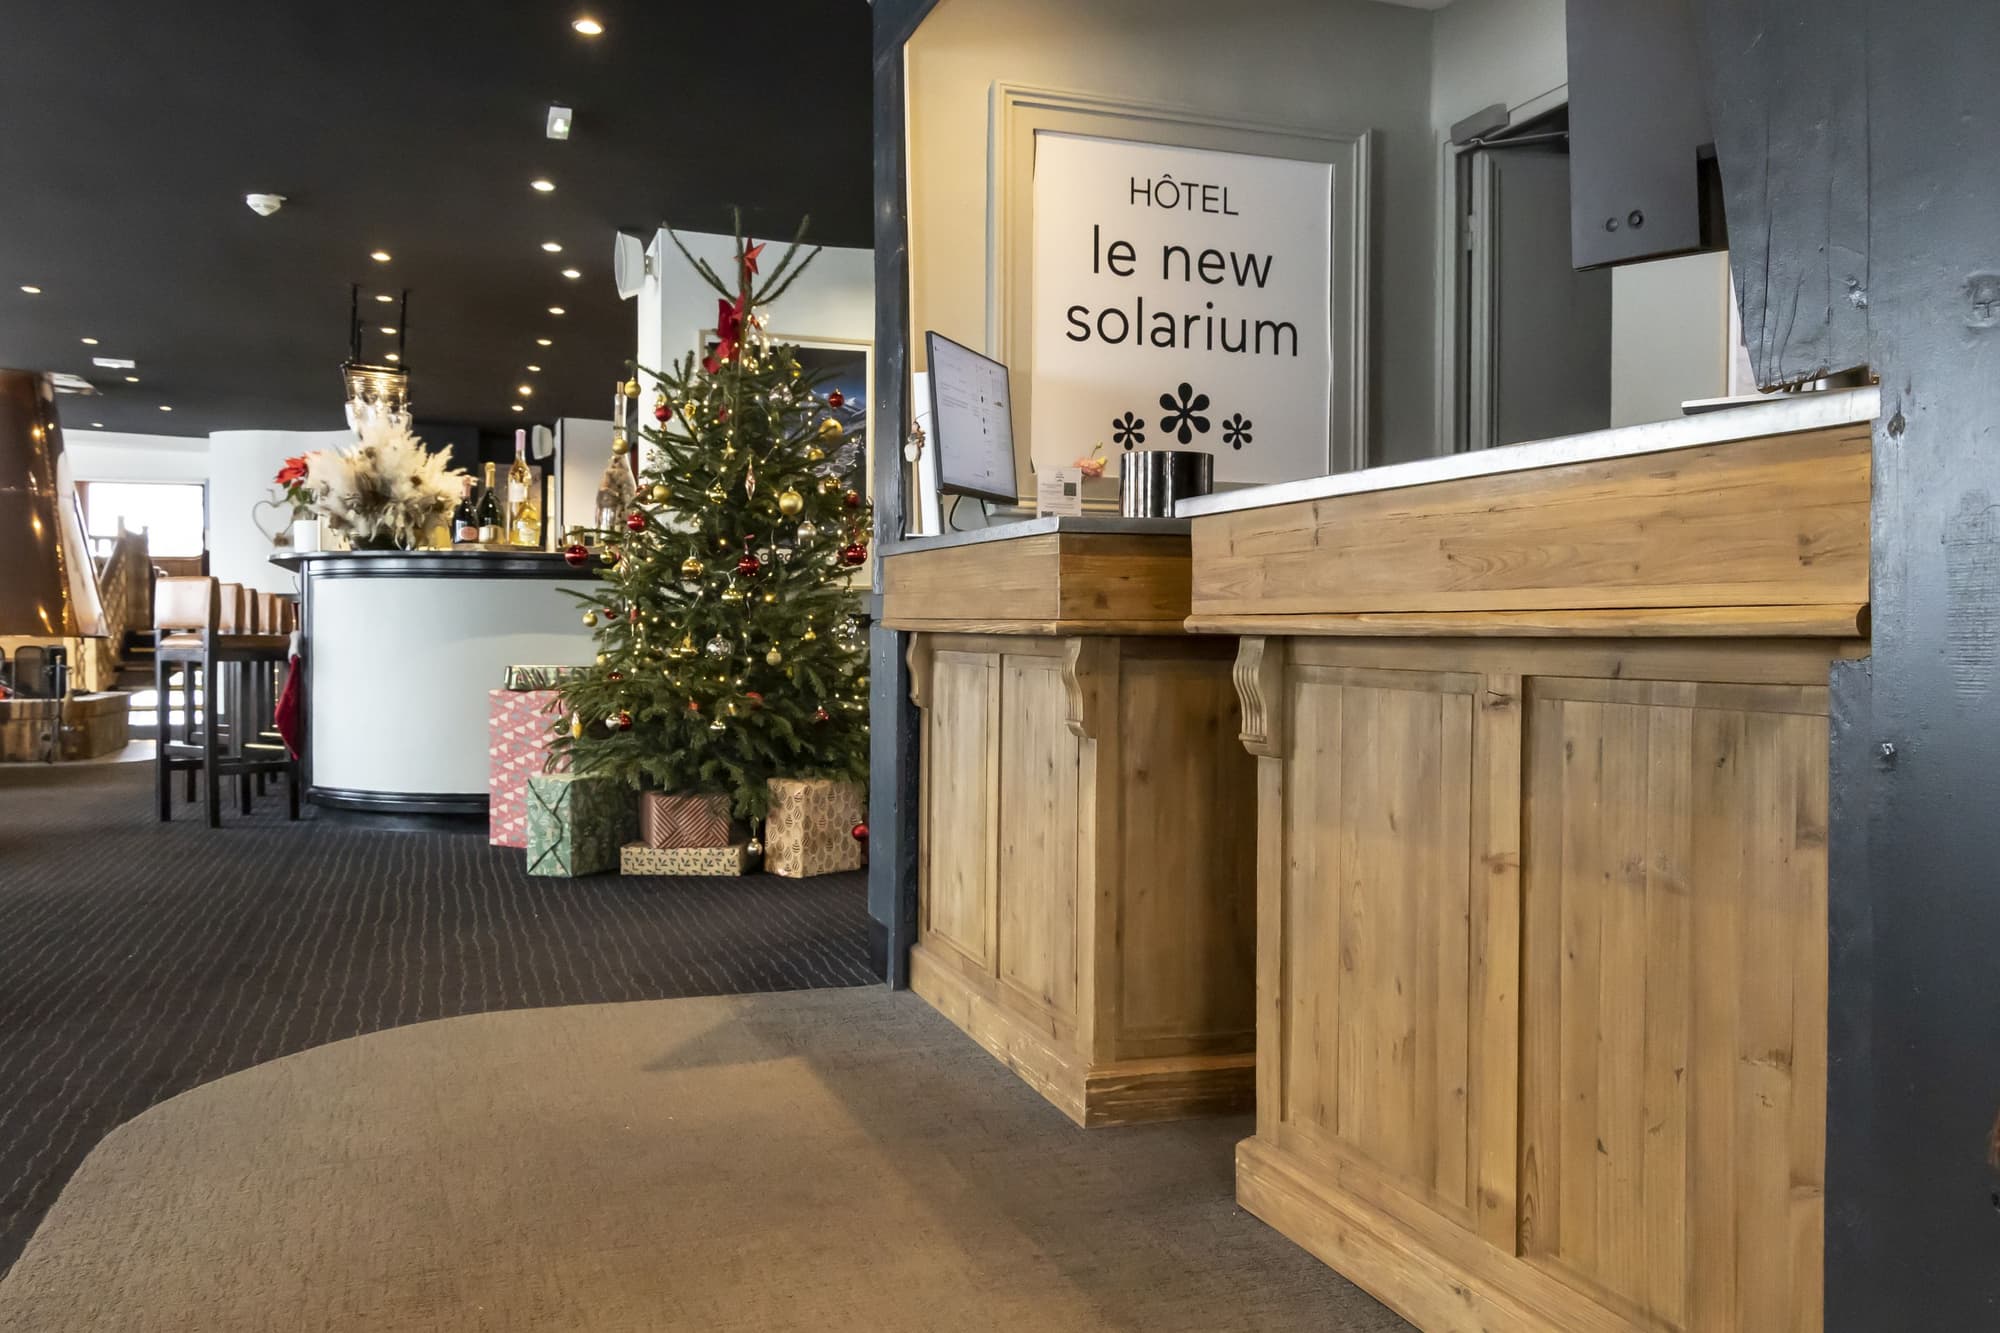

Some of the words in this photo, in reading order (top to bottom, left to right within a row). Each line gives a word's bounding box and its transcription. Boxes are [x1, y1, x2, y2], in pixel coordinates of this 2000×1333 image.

[1130, 173, 1239, 216] HÔTEL
[1093, 224, 1137, 277] le
[1163, 245, 1273, 289] new
[1066, 296, 1298, 357] solarium
